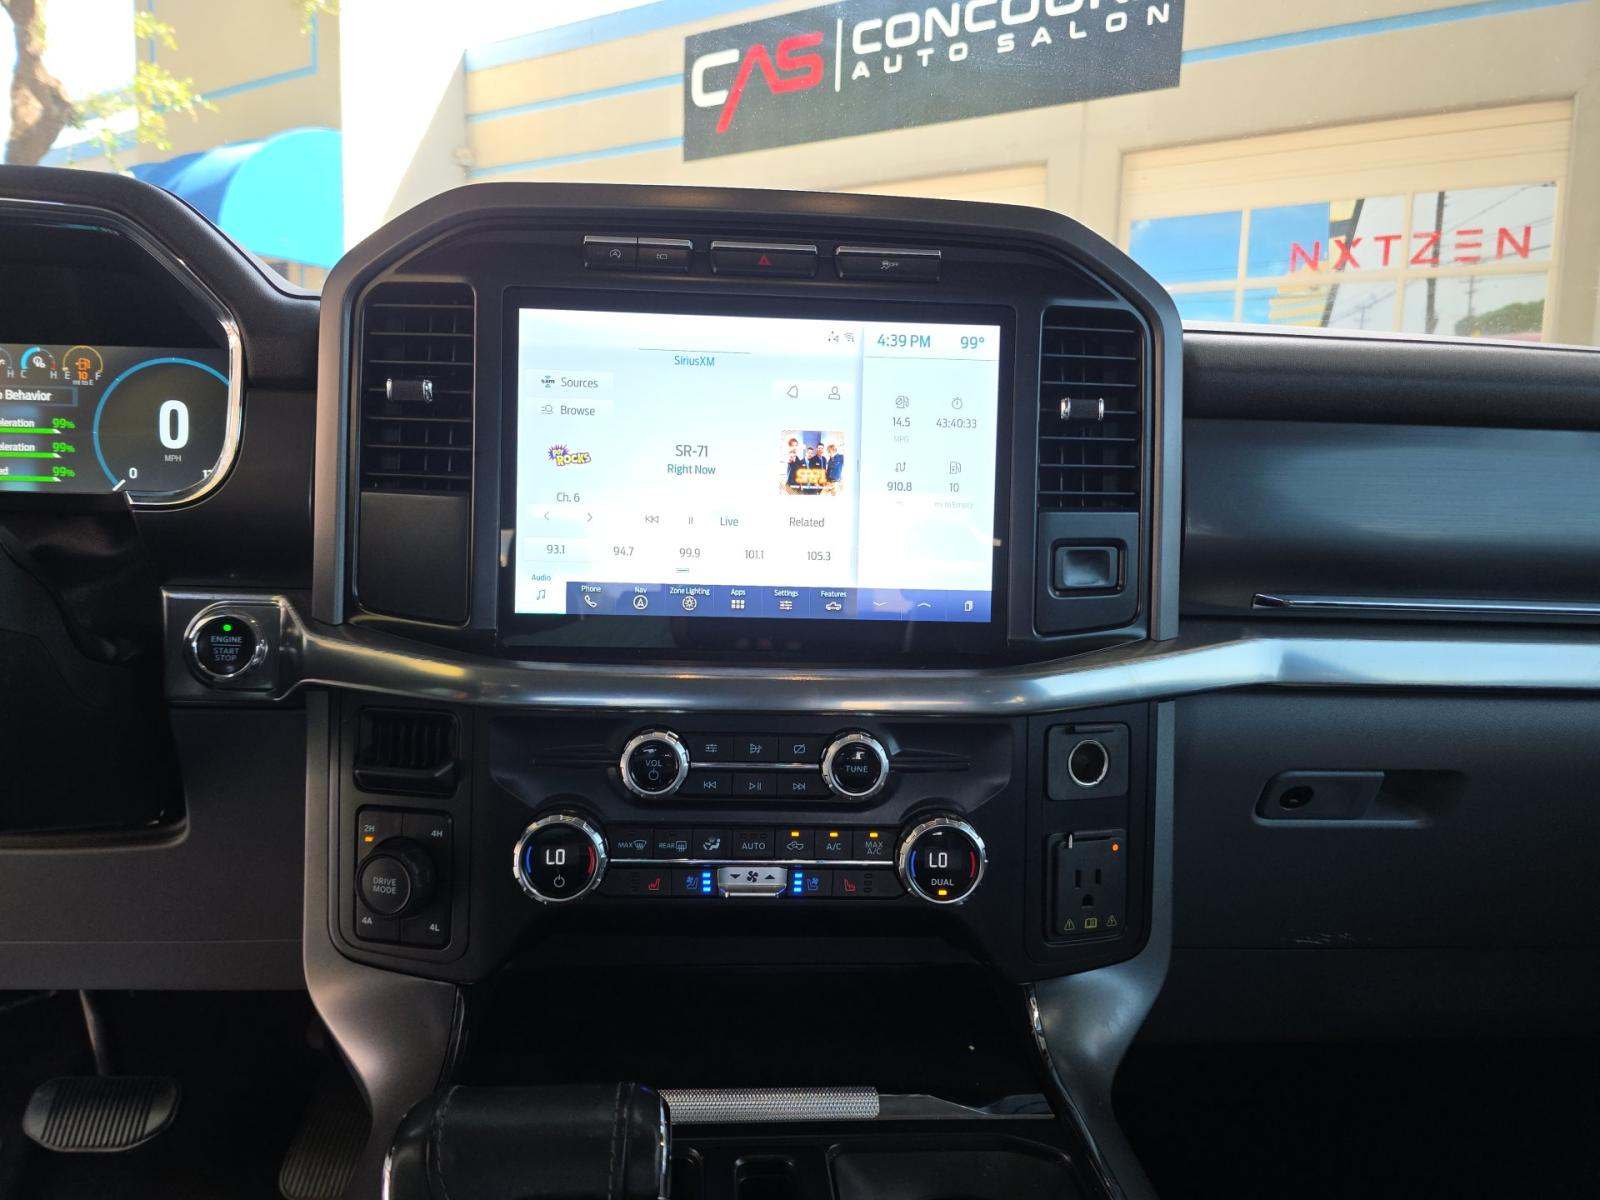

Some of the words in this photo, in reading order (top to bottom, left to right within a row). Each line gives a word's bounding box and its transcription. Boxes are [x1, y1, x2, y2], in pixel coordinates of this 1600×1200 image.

[852, 0, 1129, 55] CONCO
[851, 42, 968, 81] AUTO
[997, 3, 1170, 53] SALON
[691, 31, 825, 134] CAS
[877, 334, 907, 348] 4:39
[910, 335, 931, 348] PM
[674, 356, 715, 367] SiriusXM
[561, 377, 599, 388] Sources
[5, 389, 52, 400] Behavior
[561, 405, 596, 416] Browse
[159, 400, 190, 450] 0
[893, 417, 911, 427] 14.5
[936, 418, 977, 429] 43:40:33
[675, 445, 709, 458] SR-71
[129, 467, 138, 479] 0
[667, 464, 692, 475] Right
[694, 465, 716, 475] Now
[887, 481, 913, 492] 910.8
[949, 483, 960, 493] 10
[556, 492, 572, 502] Ch.
[573, 493, 580, 503] 6
[720, 517, 739, 527] Live
[789, 517, 825, 528] Related
[546, 545, 565, 554] 93.1
[613, 546, 634, 556] 94.7
[679, 548, 701, 558] 99.9
[807, 551, 831, 561] 105.3
[531, 574, 552, 582] Audio
[581, 585, 602, 593] Phone
[634, 586, 648, 594] Nav
[670, 587, 686, 595] Zone
[687, 587, 711, 596] Lighting
[730, 589, 746, 597] Apps
[774, 589, 799, 598] Settings
[820, 590, 847, 598] Features
[210, 635, 243, 643] ENGINE
[213, 647, 240, 655] START
[846, 765, 869, 773] TUNE
[431, 830, 443, 838] 4H
[742, 842, 766, 850] AUTO
[826, 842, 841, 850] A/C
[866, 848, 882, 856] A/C
[546, 849, 566, 866] LO
[929, 852, 948, 869] LO
[373, 877, 397, 886] DRIVE
[931, 878, 954, 886] DUAL
[373, 885, 397, 894] MODE
[361, 917, 373, 925] 4A
